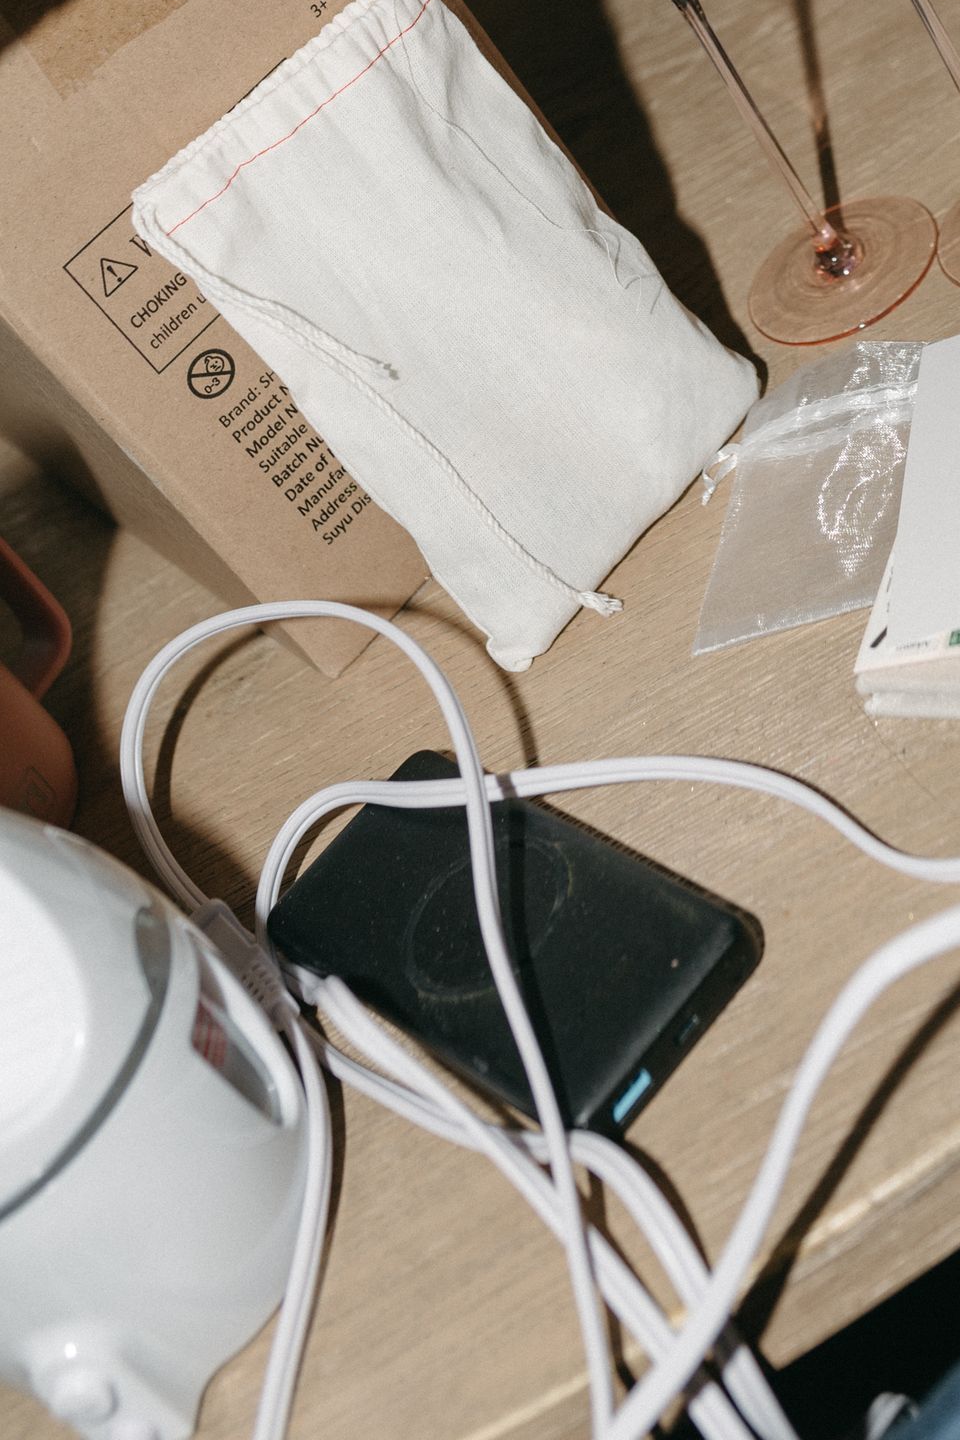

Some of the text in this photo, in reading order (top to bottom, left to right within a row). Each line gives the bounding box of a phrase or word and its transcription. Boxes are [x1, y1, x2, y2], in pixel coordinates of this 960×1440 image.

[310, 0, 328, 18] 3+
[130, 272, 188, 329] CHOKING
[150, 302, 198, 349] children
[203, 376, 221, 394] 0-3
[218, 387, 262, 428] Brand:
[232, 394, 282, 443] Product
[245, 414, 287, 458] Model
[258, 423, 308, 474] Suitable
[271, 451, 308, 487] Batch
[284, 452, 329, 502] Date of
[311, 481, 358, 532] Address
[322, 513, 354, 545] Suyu
